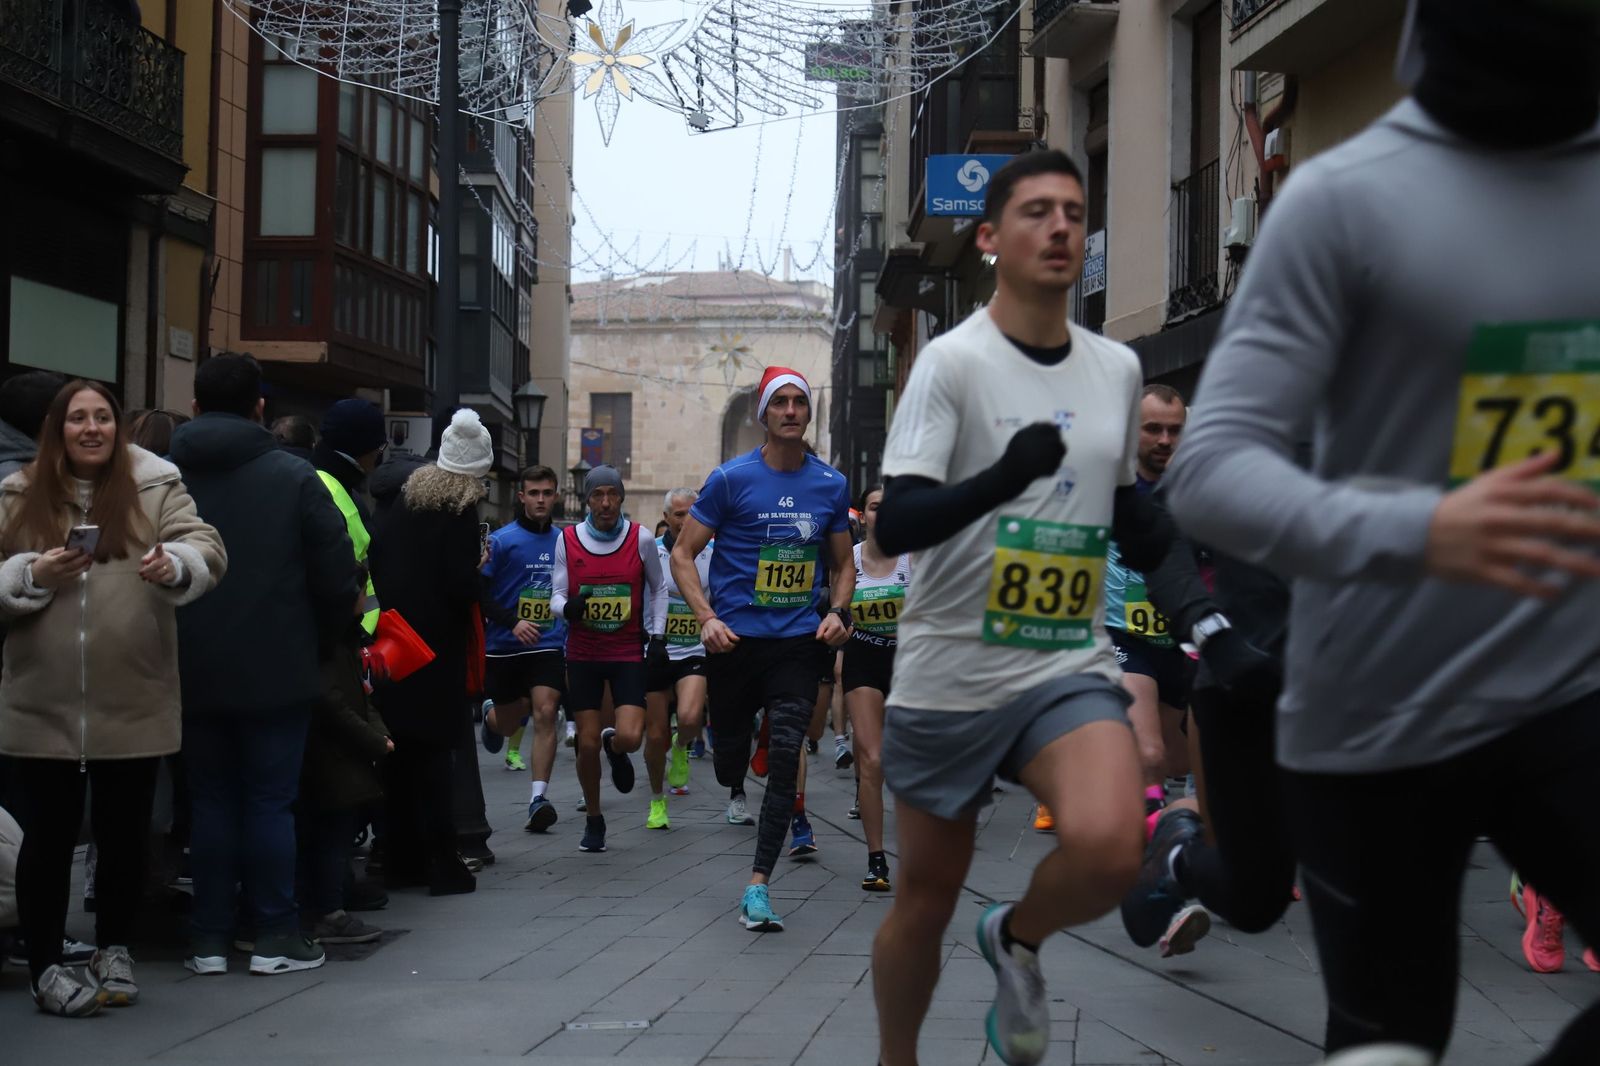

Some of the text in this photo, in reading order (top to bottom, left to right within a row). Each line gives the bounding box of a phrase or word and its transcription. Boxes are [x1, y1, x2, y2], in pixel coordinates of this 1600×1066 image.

[778, 496, 794, 508] 46
[538, 553, 550, 561] 46
[765, 563, 805, 588] 1134
[997, 562, 1091, 616] 839
[854, 601, 897, 621] 140
[853, 630, 885, 646] NIKE
